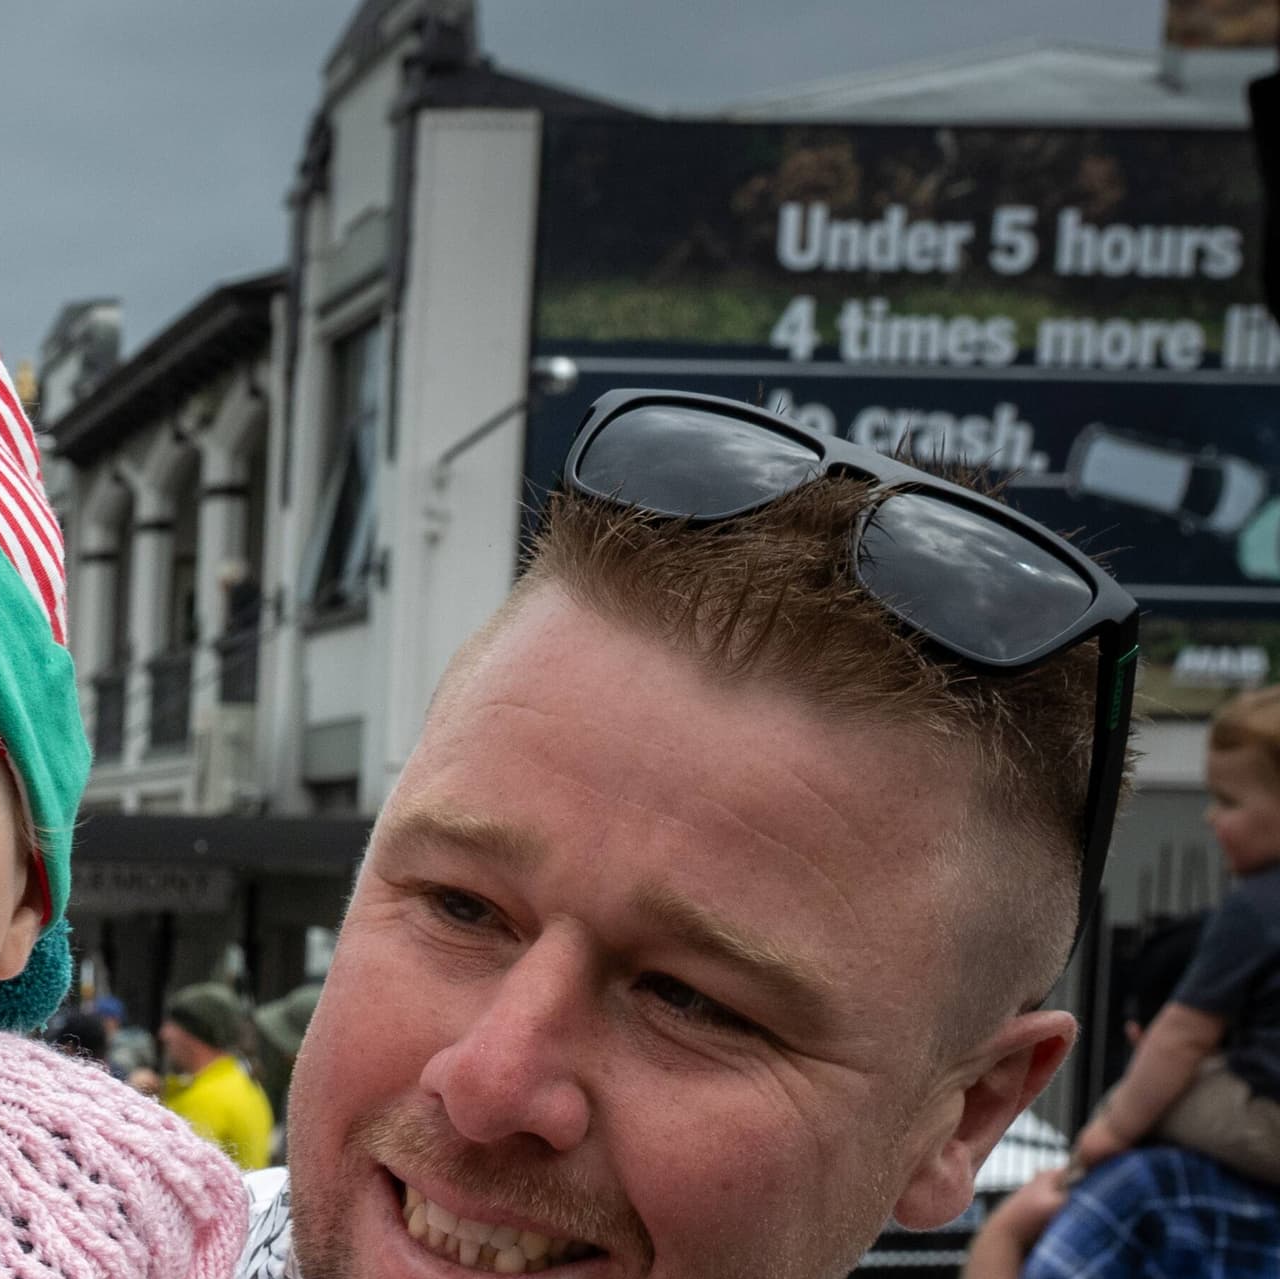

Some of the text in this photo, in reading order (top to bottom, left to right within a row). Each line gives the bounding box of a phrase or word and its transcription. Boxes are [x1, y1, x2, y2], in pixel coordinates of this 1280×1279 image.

[776, 203, 1244, 280] Under 5 hours
[770, 295, 821, 362] 4
[836, 297, 1019, 368] times
[1034, 313, 1206, 371] more
[853, 402, 1049, 472] crash.
